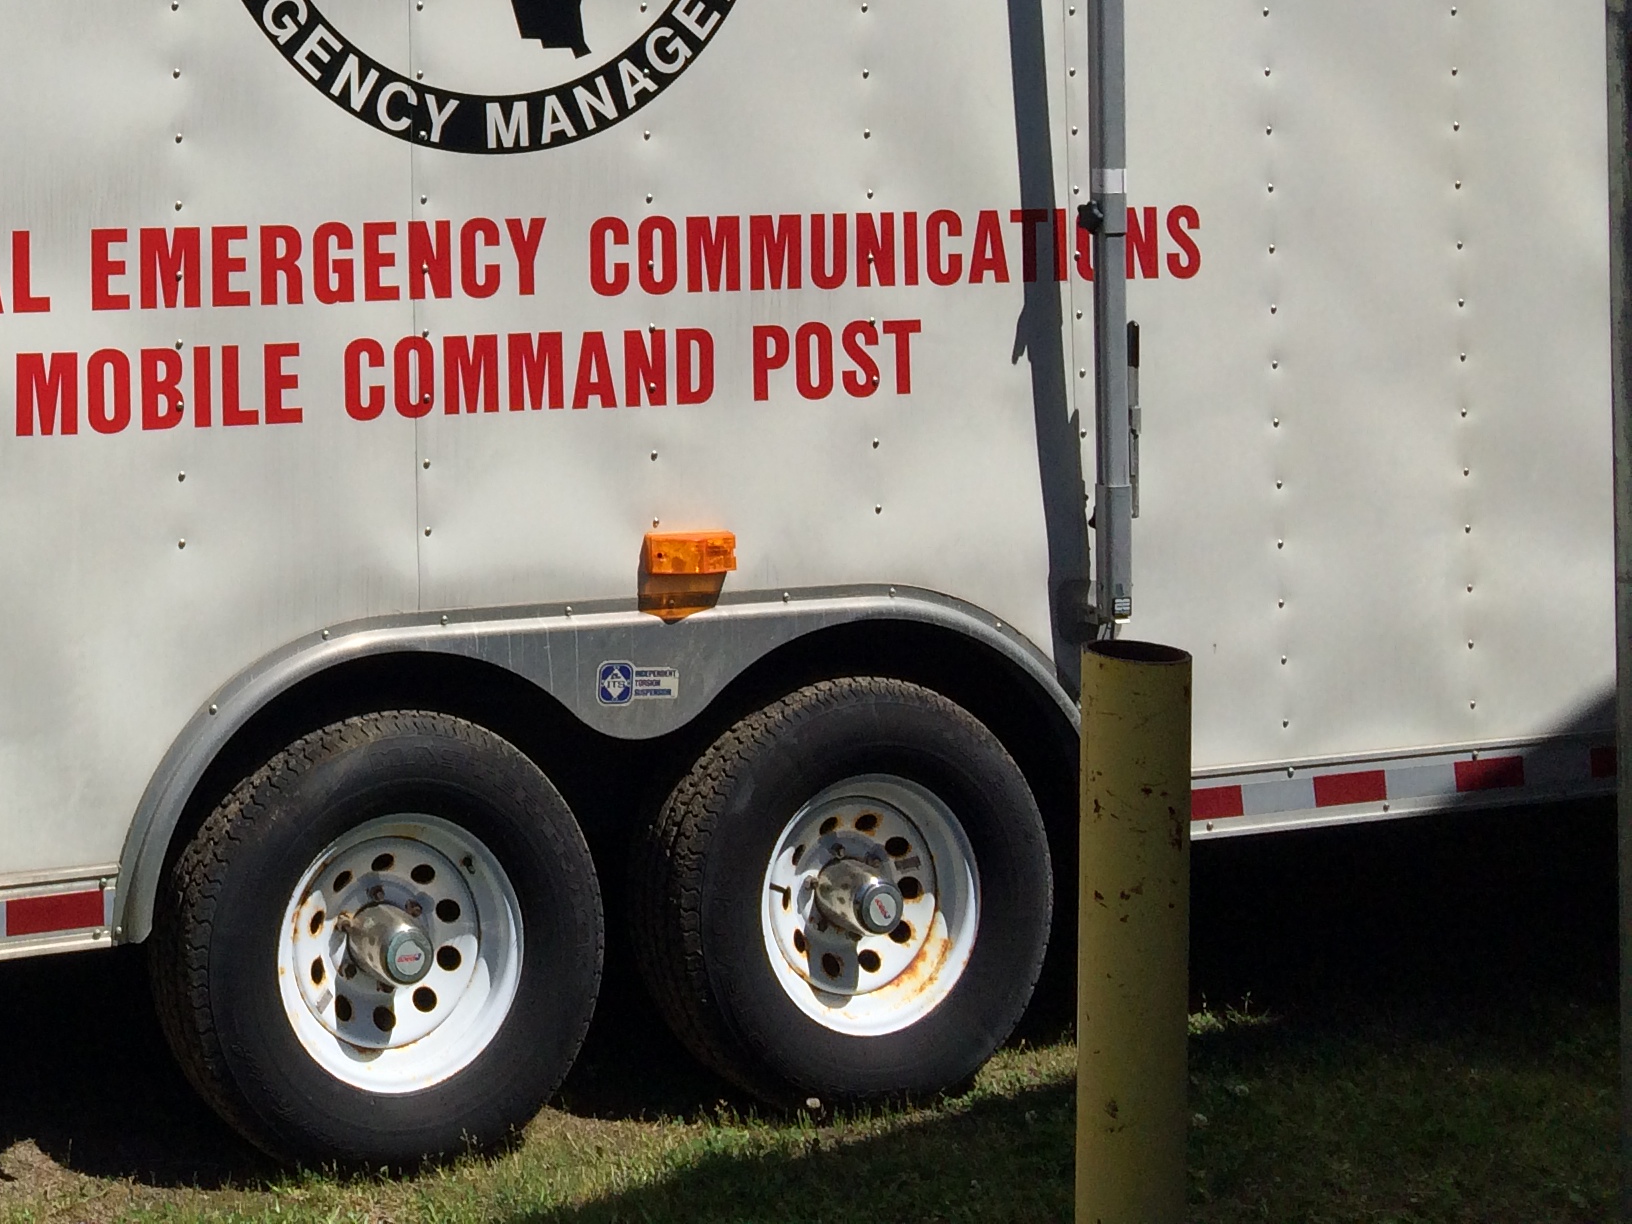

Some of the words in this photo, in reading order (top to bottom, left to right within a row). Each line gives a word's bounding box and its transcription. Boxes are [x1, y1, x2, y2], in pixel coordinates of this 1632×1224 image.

[91, 217, 546, 311] EMERGENCY
[16, 342, 303, 437] MOBILE
[344, 327, 715, 421] COMMAND
[753, 319, 922, 402] POST
[607, 680, 625, 688] ITS
